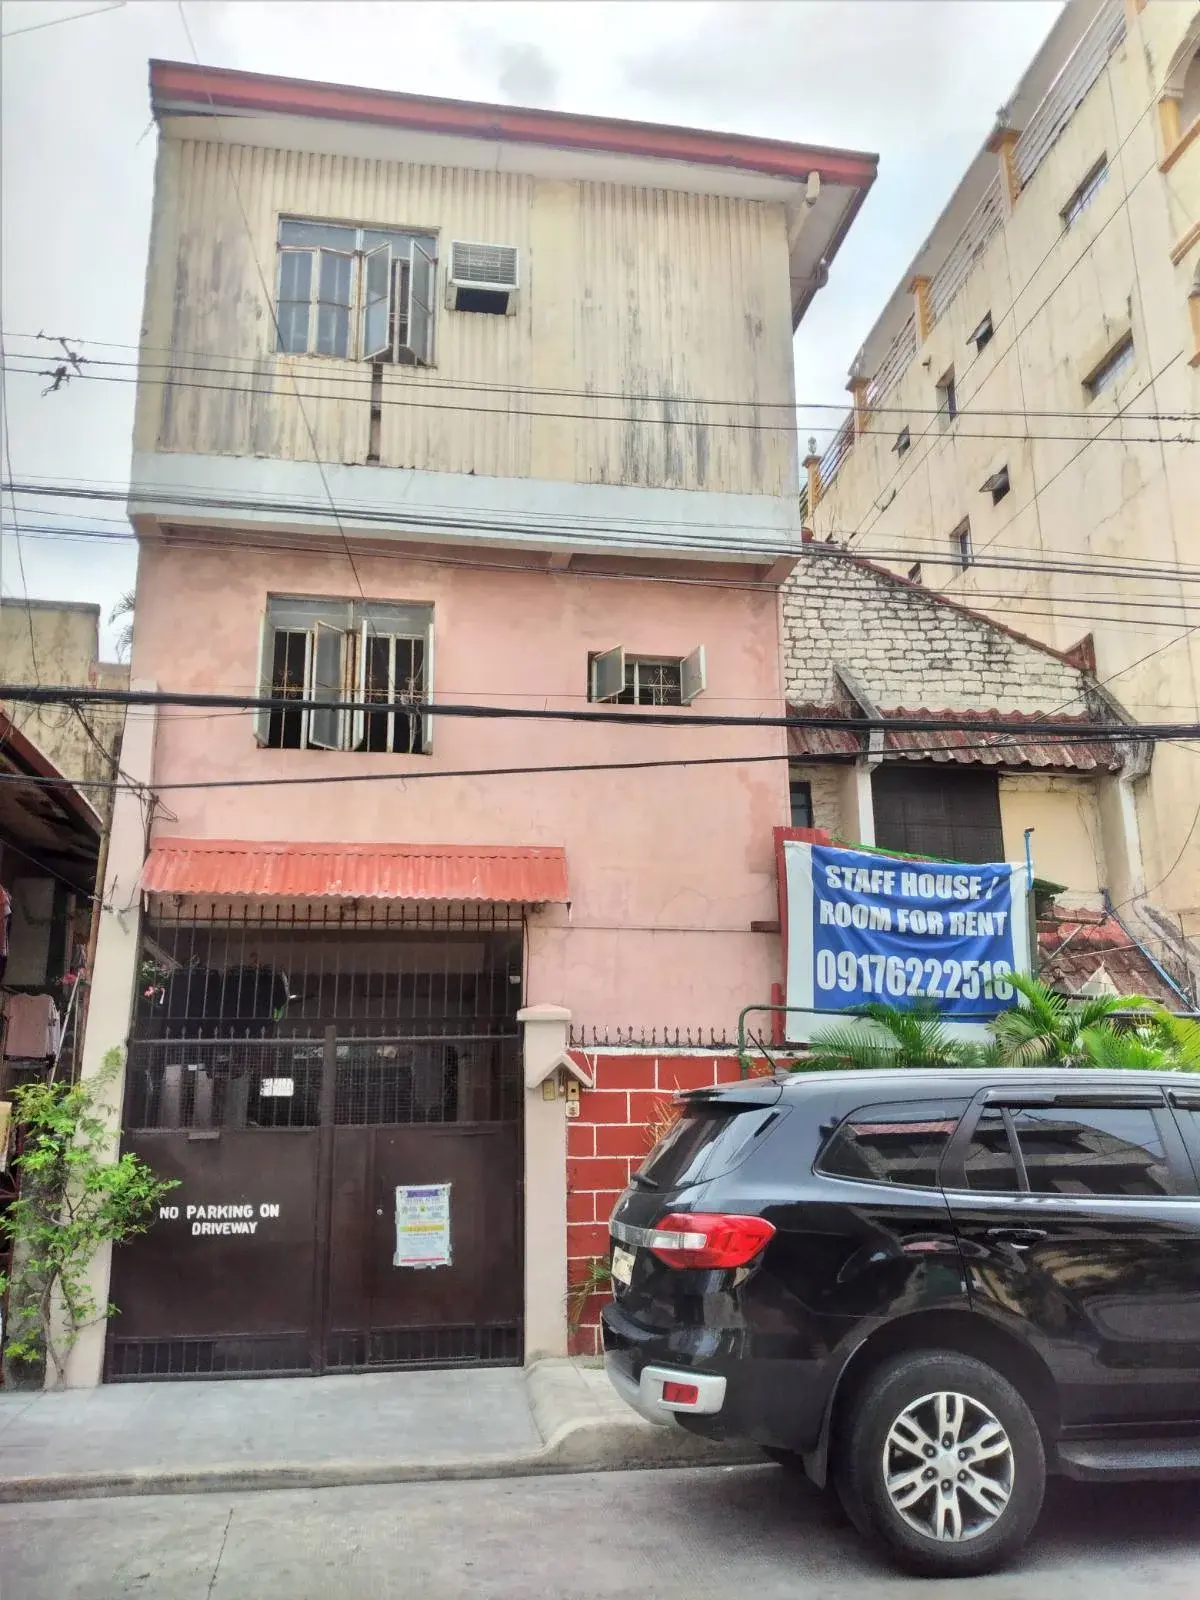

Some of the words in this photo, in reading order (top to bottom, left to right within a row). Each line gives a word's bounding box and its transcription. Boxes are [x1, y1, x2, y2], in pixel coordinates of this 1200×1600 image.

[826, 865, 895, 895] STAFF
[901, 873, 982, 900] HOUSE
[986, 877, 999, 899] /
[819, 900, 891, 931] ROOM
[896, 908, 944, 935] FOR
[950, 911, 1007, 936] RENT
[816, 949, 1013, 1000] 09176222518
[159, 1206, 179, 1219] NO
[186, 1204, 253, 1219] PARKING
[259, 1203, 280, 1218] ON
[191, 1221, 258, 1236] DRIVEWAY
